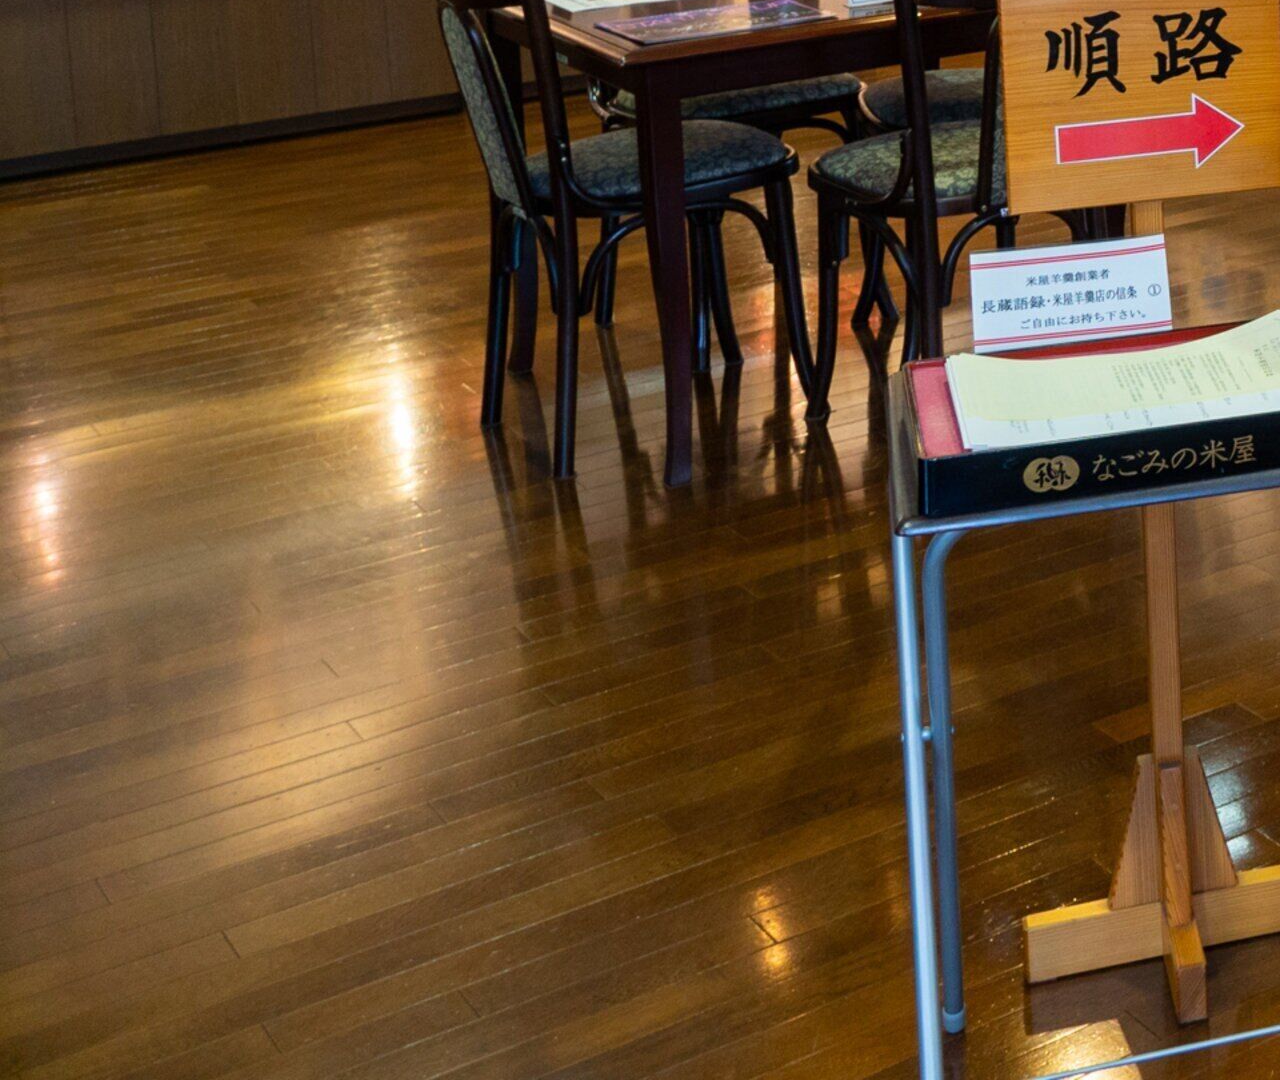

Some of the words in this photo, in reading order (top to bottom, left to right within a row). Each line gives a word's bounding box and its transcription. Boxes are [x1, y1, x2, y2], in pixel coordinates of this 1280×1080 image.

[1045, 6, 1243, 100] 順路
[1025, 269, 1111, 287] 米屋羊羹創業者
[1020, 310, 1148, 330] ご自由にお持ち下さい。
[1092, 434, 1258, 482] なごみの米屋
